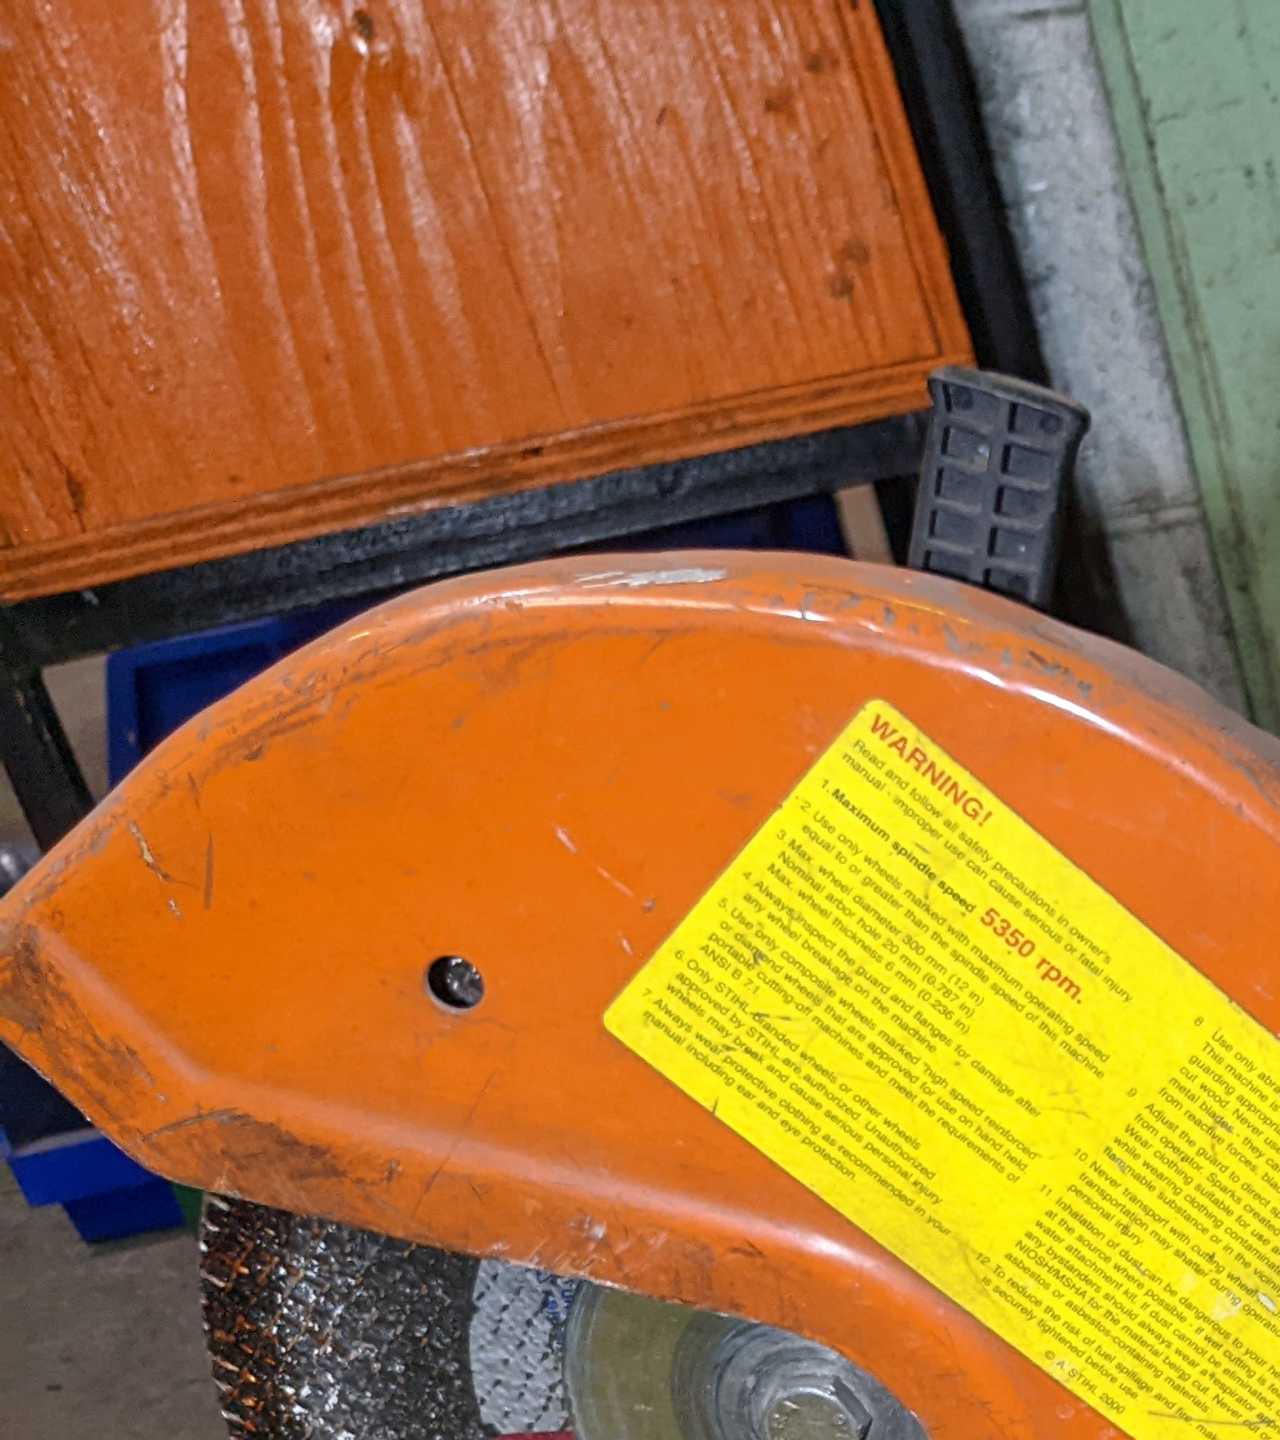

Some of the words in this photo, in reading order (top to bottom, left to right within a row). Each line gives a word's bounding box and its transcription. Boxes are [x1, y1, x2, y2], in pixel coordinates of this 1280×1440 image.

[870, 714, 992, 826] WARNING!
[831, 787, 890, 841] Maximum
[891, 840, 937, 881] spindle
[937, 879, 976, 913] speed
[979, 907, 1035, 957] 5350
[1035, 957, 1081, 1004] rpm.
[841, 751, 886, 791] manual
[892, 794, 943, 840] improper
[943, 839, 966, 860] use
[965, 858, 988, 879] can
[988, 878, 1022, 909] cause
[1022, 907, 1063, 944] serious
[1063, 942, 1077, 955] or
[1077, 952, 1104, 976] fatal
[852, 738, 886, 770] Read
[884, 768, 910, 790] and
[908, 787, 943, 818] follow
[942, 818, 959, 833] all
[957, 831, 993, 863] safety
[991, 861, 1056, 917] precautions
[1056, 913, 1069, 927] in
[1068, 926, 1111, 964] owner's
[742, 892, 765, 912] any
[766, 911, 802, 941] wheel
[800, 938, 853, 987] breakage
[853, 983, 870, 998] on
[871, 996, 889, 1014] the
[777, 850, 826, 893] Nominal
[824, 892, 855, 918] arbor
[855, 916, 882, 941] hole
[880, 937, 899, 954] 20
[898, 953, 921, 974] mm
[957, 1001, 975, 1018] in)
[797, 888, 832, 919] wheel
[831, 916, 883, 963] thickness
[884, 960, 895, 971] 6
[894, 970, 917, 991] mm
[916, 988, 954, 1020] (0.236
[953, 1018, 970, 1035] in)
[801, 824, 836, 853] equal
[834, 850, 847, 864] to
[847, 863, 862, 875] or
[860, 875, 904, 910] greater
[903, 908, 930, 934] than
[929, 930, 949, 950] the
[949, 948, 989, 983] spindle
[989, 981, 1026, 1012] speed
[1024, 1010, 1040, 1023] of
[1037, 1020, 1058, 1041] this
[812, 810, 836, 834] Use
[836, 833, 863, 856] only
[863, 854, 903, 890] wheels
[903, 888, 947, 926] marked
[946, 923, 970, 946] with
[969, 944, 1023, 991] maximum
[1023, 990, 1074, 1035] operating
[1073, 1032, 1110, 1063] speed
[818, 864, 853, 895] wheel
[851, 894, 902, 936] diameter
[901, 933, 926, 956] 300
[923, 954, 947, 975] mm
[947, 973, 969, 992] (12
[967, 990, 984, 1006] in)
[1201, 1041, 1224, 1065] This
[1223, 1063, 1268, 1102] machine
[1268, 1100, 1280, 1112] is
[1211, 1028, 1233, 1052] Use
[1233, 1051, 1257, 1073] only
[1067, 1367, 1097, 1393] STIHL
[1098, 1392, 1125, 1414] 2000
